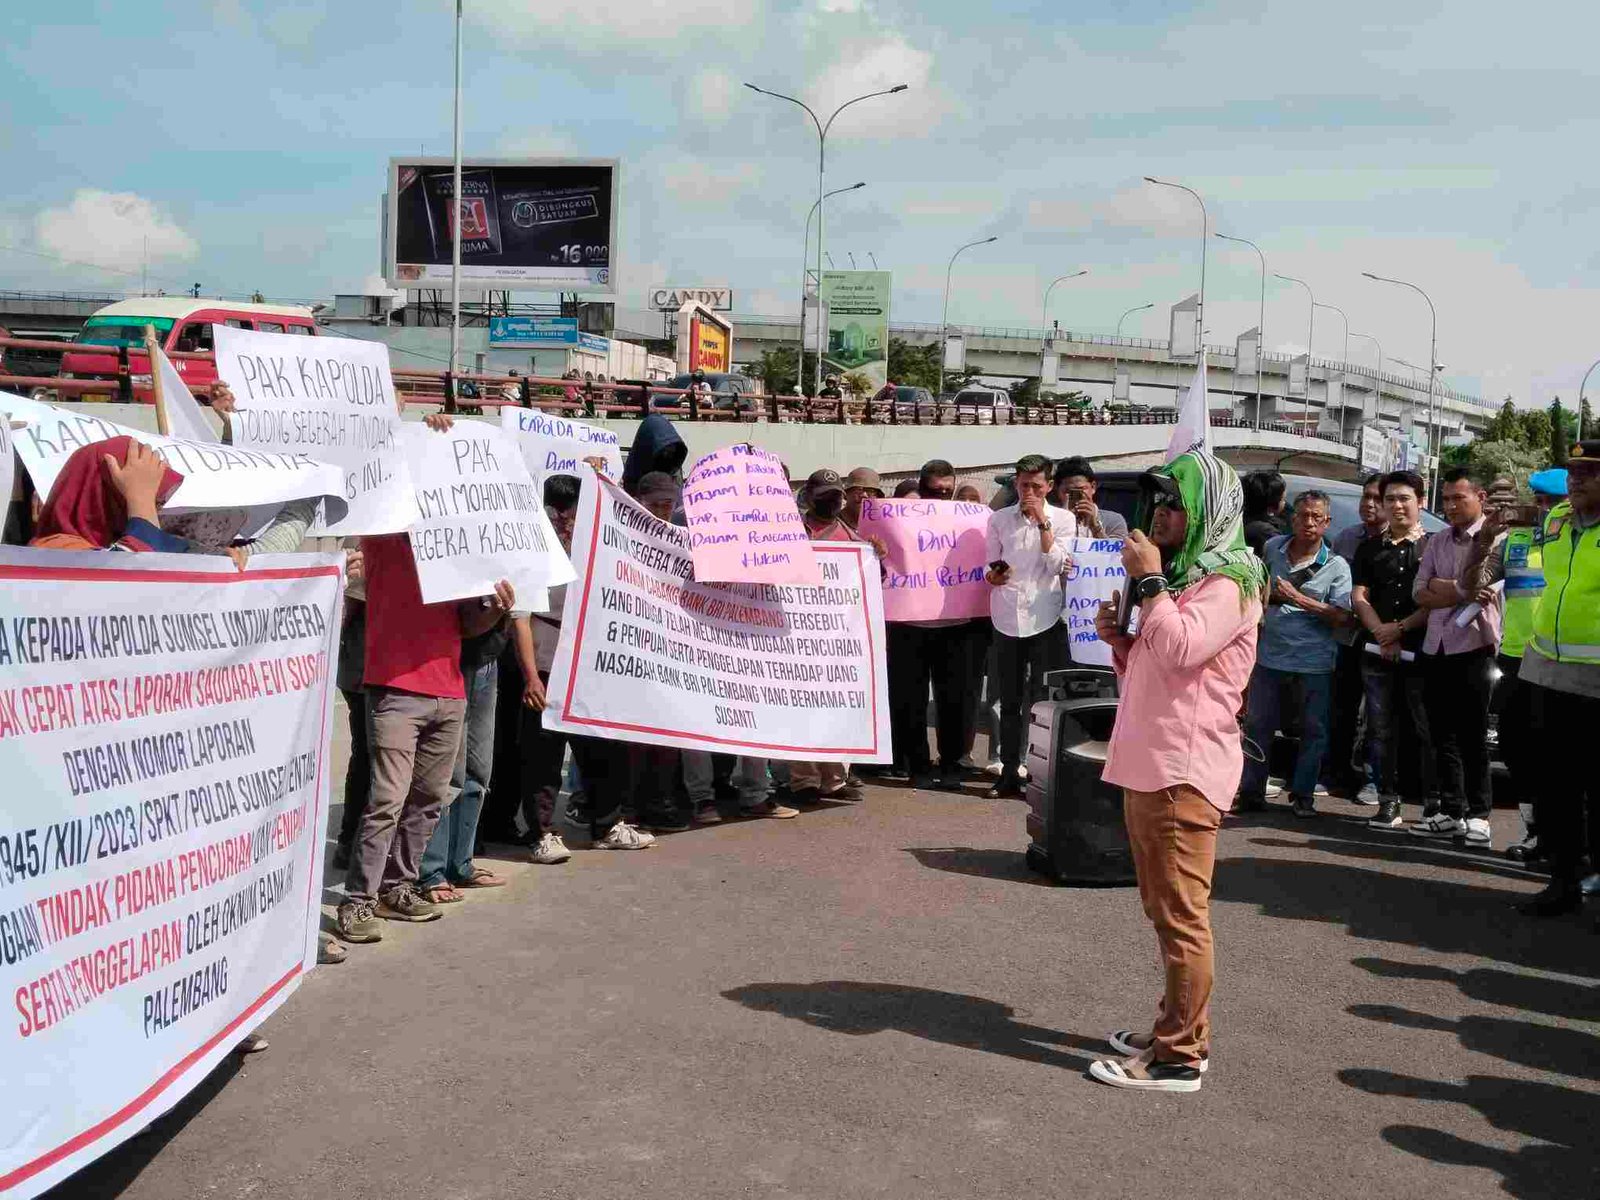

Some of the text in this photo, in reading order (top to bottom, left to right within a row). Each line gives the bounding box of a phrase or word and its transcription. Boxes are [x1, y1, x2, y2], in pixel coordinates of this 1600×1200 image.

[560, 244, 581, 264] 16
[654, 290, 726, 308] CANDY
[237, 355, 385, 406] PAK KAPOLDA
[698, 350, 722, 370] CANDY
[236, 409, 290, 445] TOLONG
[519, 411, 574, 438] KAPOLDA
[451, 438, 500, 475] PAK
[450, 482, 509, 514] MOHON
[861, 499, 938, 521] PERIKSA
[477, 521, 533, 554] KASUS
[612, 500, 668, 541] MEMINTA
[692, 532, 739, 547] DALAM
[917, 529, 957, 553] DAN
[630, 539, 673, 574] SEGERA
[759, 583, 795, 604] TEGAS
[795, 586, 860, 606] TERHADAP
[601, 586, 633, 615] YANG
[664, 609, 692, 638] TELAH
[691, 619, 752, 652] MELAKUKAN
[751, 633, 796, 656] DUGAAN
[797, 637, 863, 658] PENCURIAN
[680, 589, 709, 616] BANK
[706, 598, 724, 622] BRI
[723, 601, 784, 628] PALEMBANG
[785, 611, 850, 632] TERSEBUT,
[13, 615, 87, 665] KEPADA
[88, 612, 162, 660] KAPOLDA
[161, 608, 227, 654] SUMSEL
[221, 608, 270, 648] UNTUK
[270, 603, 327, 642] SEGERA
[607, 620, 859, 683] & PENIPUAN SERTA PENGGELAPAN TERHADAP UANG
[22, 683, 77, 734] CEPAT
[80, 678, 123, 726] ATAS
[123, 666, 194, 718] LAPORAN
[195, 663, 263, 708] SAUDARA
[260, 658, 288, 696] EVI
[594, 649, 866, 709] NASABAH BANK BRI PALEMBANG YANG BERNAMA EVI
[714, 704, 759, 730] SUSANTI
[62, 717, 257, 796] DENGAN NOMOR LAPORAN
[37, 878, 112, 946] TINDAK
[115, 857, 178, 920] PIDANA
[178, 831, 252, 896] PENCURIAN
[14, 959, 71, 1038] SERTA
[68, 920, 184, 1011] PENGGELAPAN
[186, 908, 220, 955] OLEH
[222, 880, 259, 938] OKNUM
[258, 865, 286, 914] BANK
[143, 956, 229, 1039] PALEMBANG
